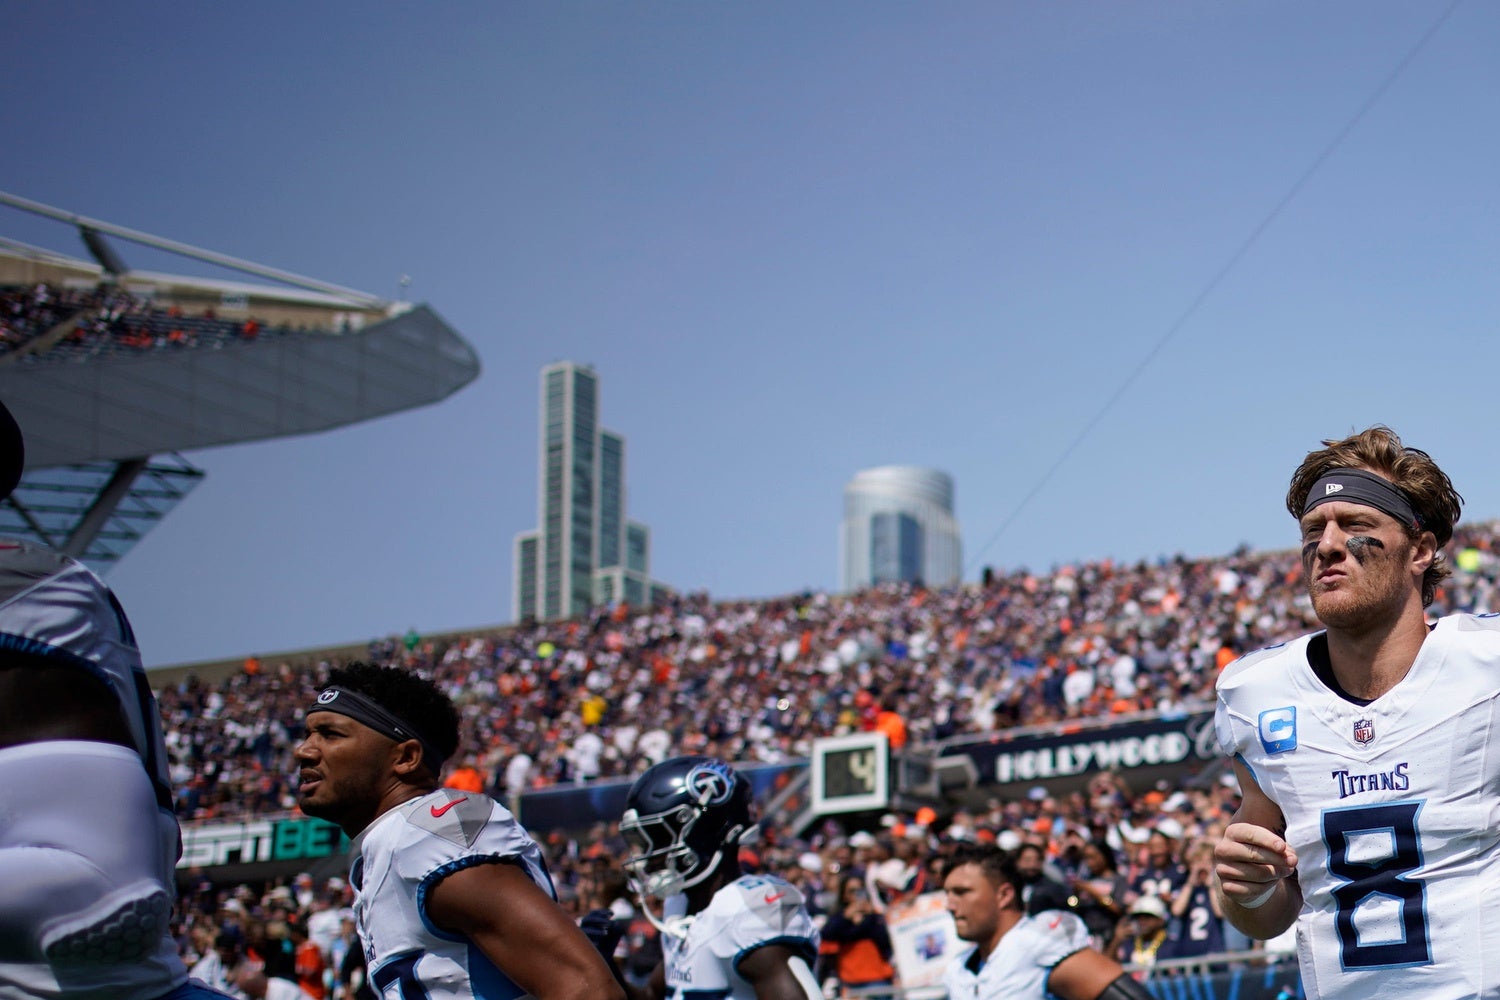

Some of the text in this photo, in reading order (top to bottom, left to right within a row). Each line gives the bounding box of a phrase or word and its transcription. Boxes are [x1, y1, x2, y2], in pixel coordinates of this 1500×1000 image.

[1261, 709, 1294, 743] C
[995, 731, 1190, 784] HOLLYWOOD
[1332, 762, 1410, 799] TITANS
[1320, 798, 1434, 972] 8
[1189, 906, 1210, 940] 2
